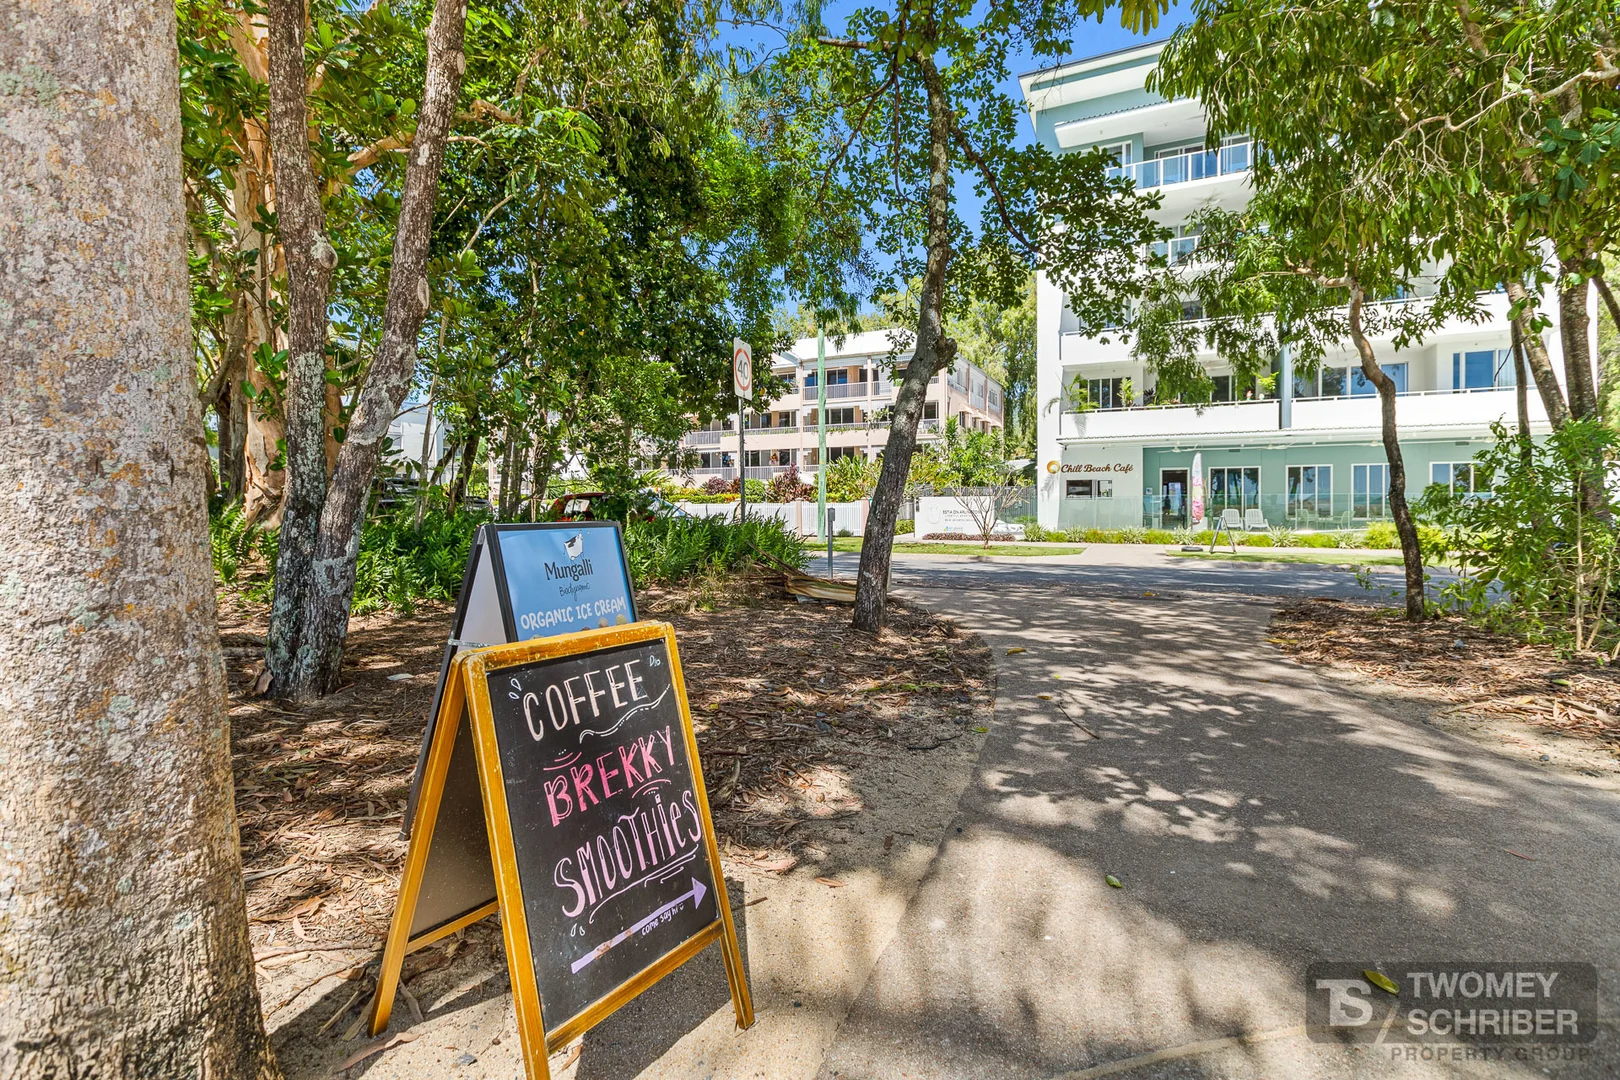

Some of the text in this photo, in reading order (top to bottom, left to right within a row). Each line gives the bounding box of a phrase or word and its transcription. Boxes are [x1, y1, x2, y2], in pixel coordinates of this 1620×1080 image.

[738, 360, 748, 380] 40
[1061, 463, 1133, 474] Chill Beach Café
[544, 559, 593, 581] Mungalli
[520, 596, 627, 631] ORGANIC ICE CREAM
[523, 659, 648, 742] COFFEE
[543, 725, 675, 828] BREKKY
[641, 907, 679, 936] come say hi
